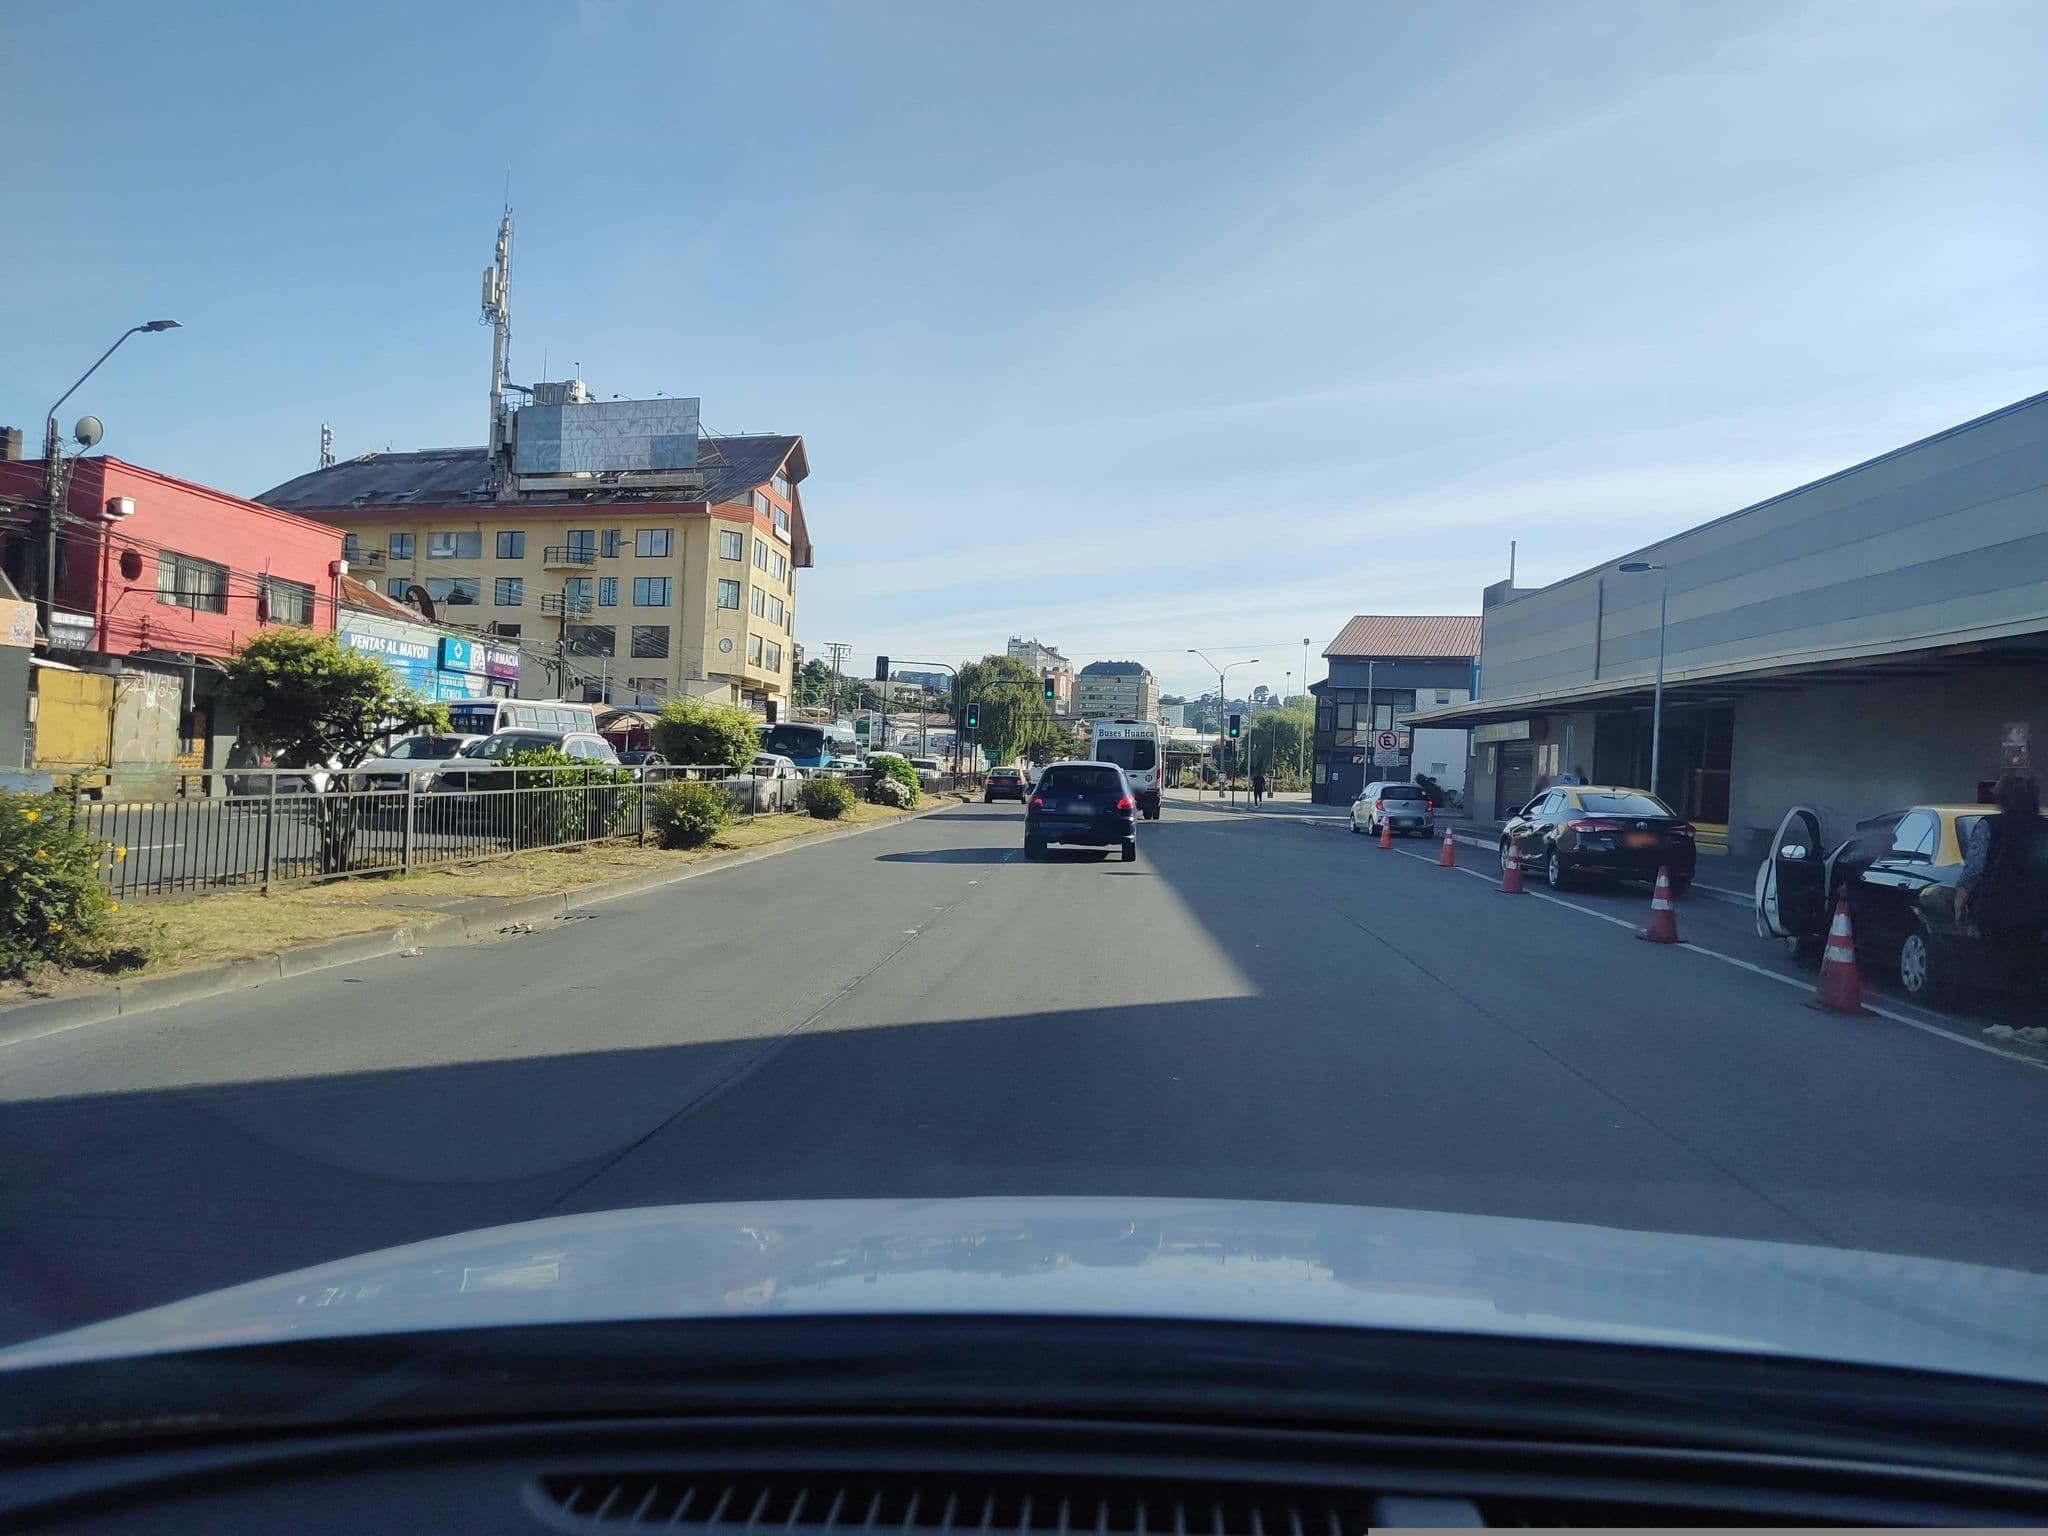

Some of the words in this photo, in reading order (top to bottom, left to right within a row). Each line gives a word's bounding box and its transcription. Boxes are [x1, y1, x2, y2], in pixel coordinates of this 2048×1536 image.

[350, 633, 386, 651] VENTAS
[386, 640, 398, 655] AL
[399, 642, 429, 660] MAYOR
[487, 650, 519, 668] FARMACIA
[1099, 729, 1121, 737] Buses
